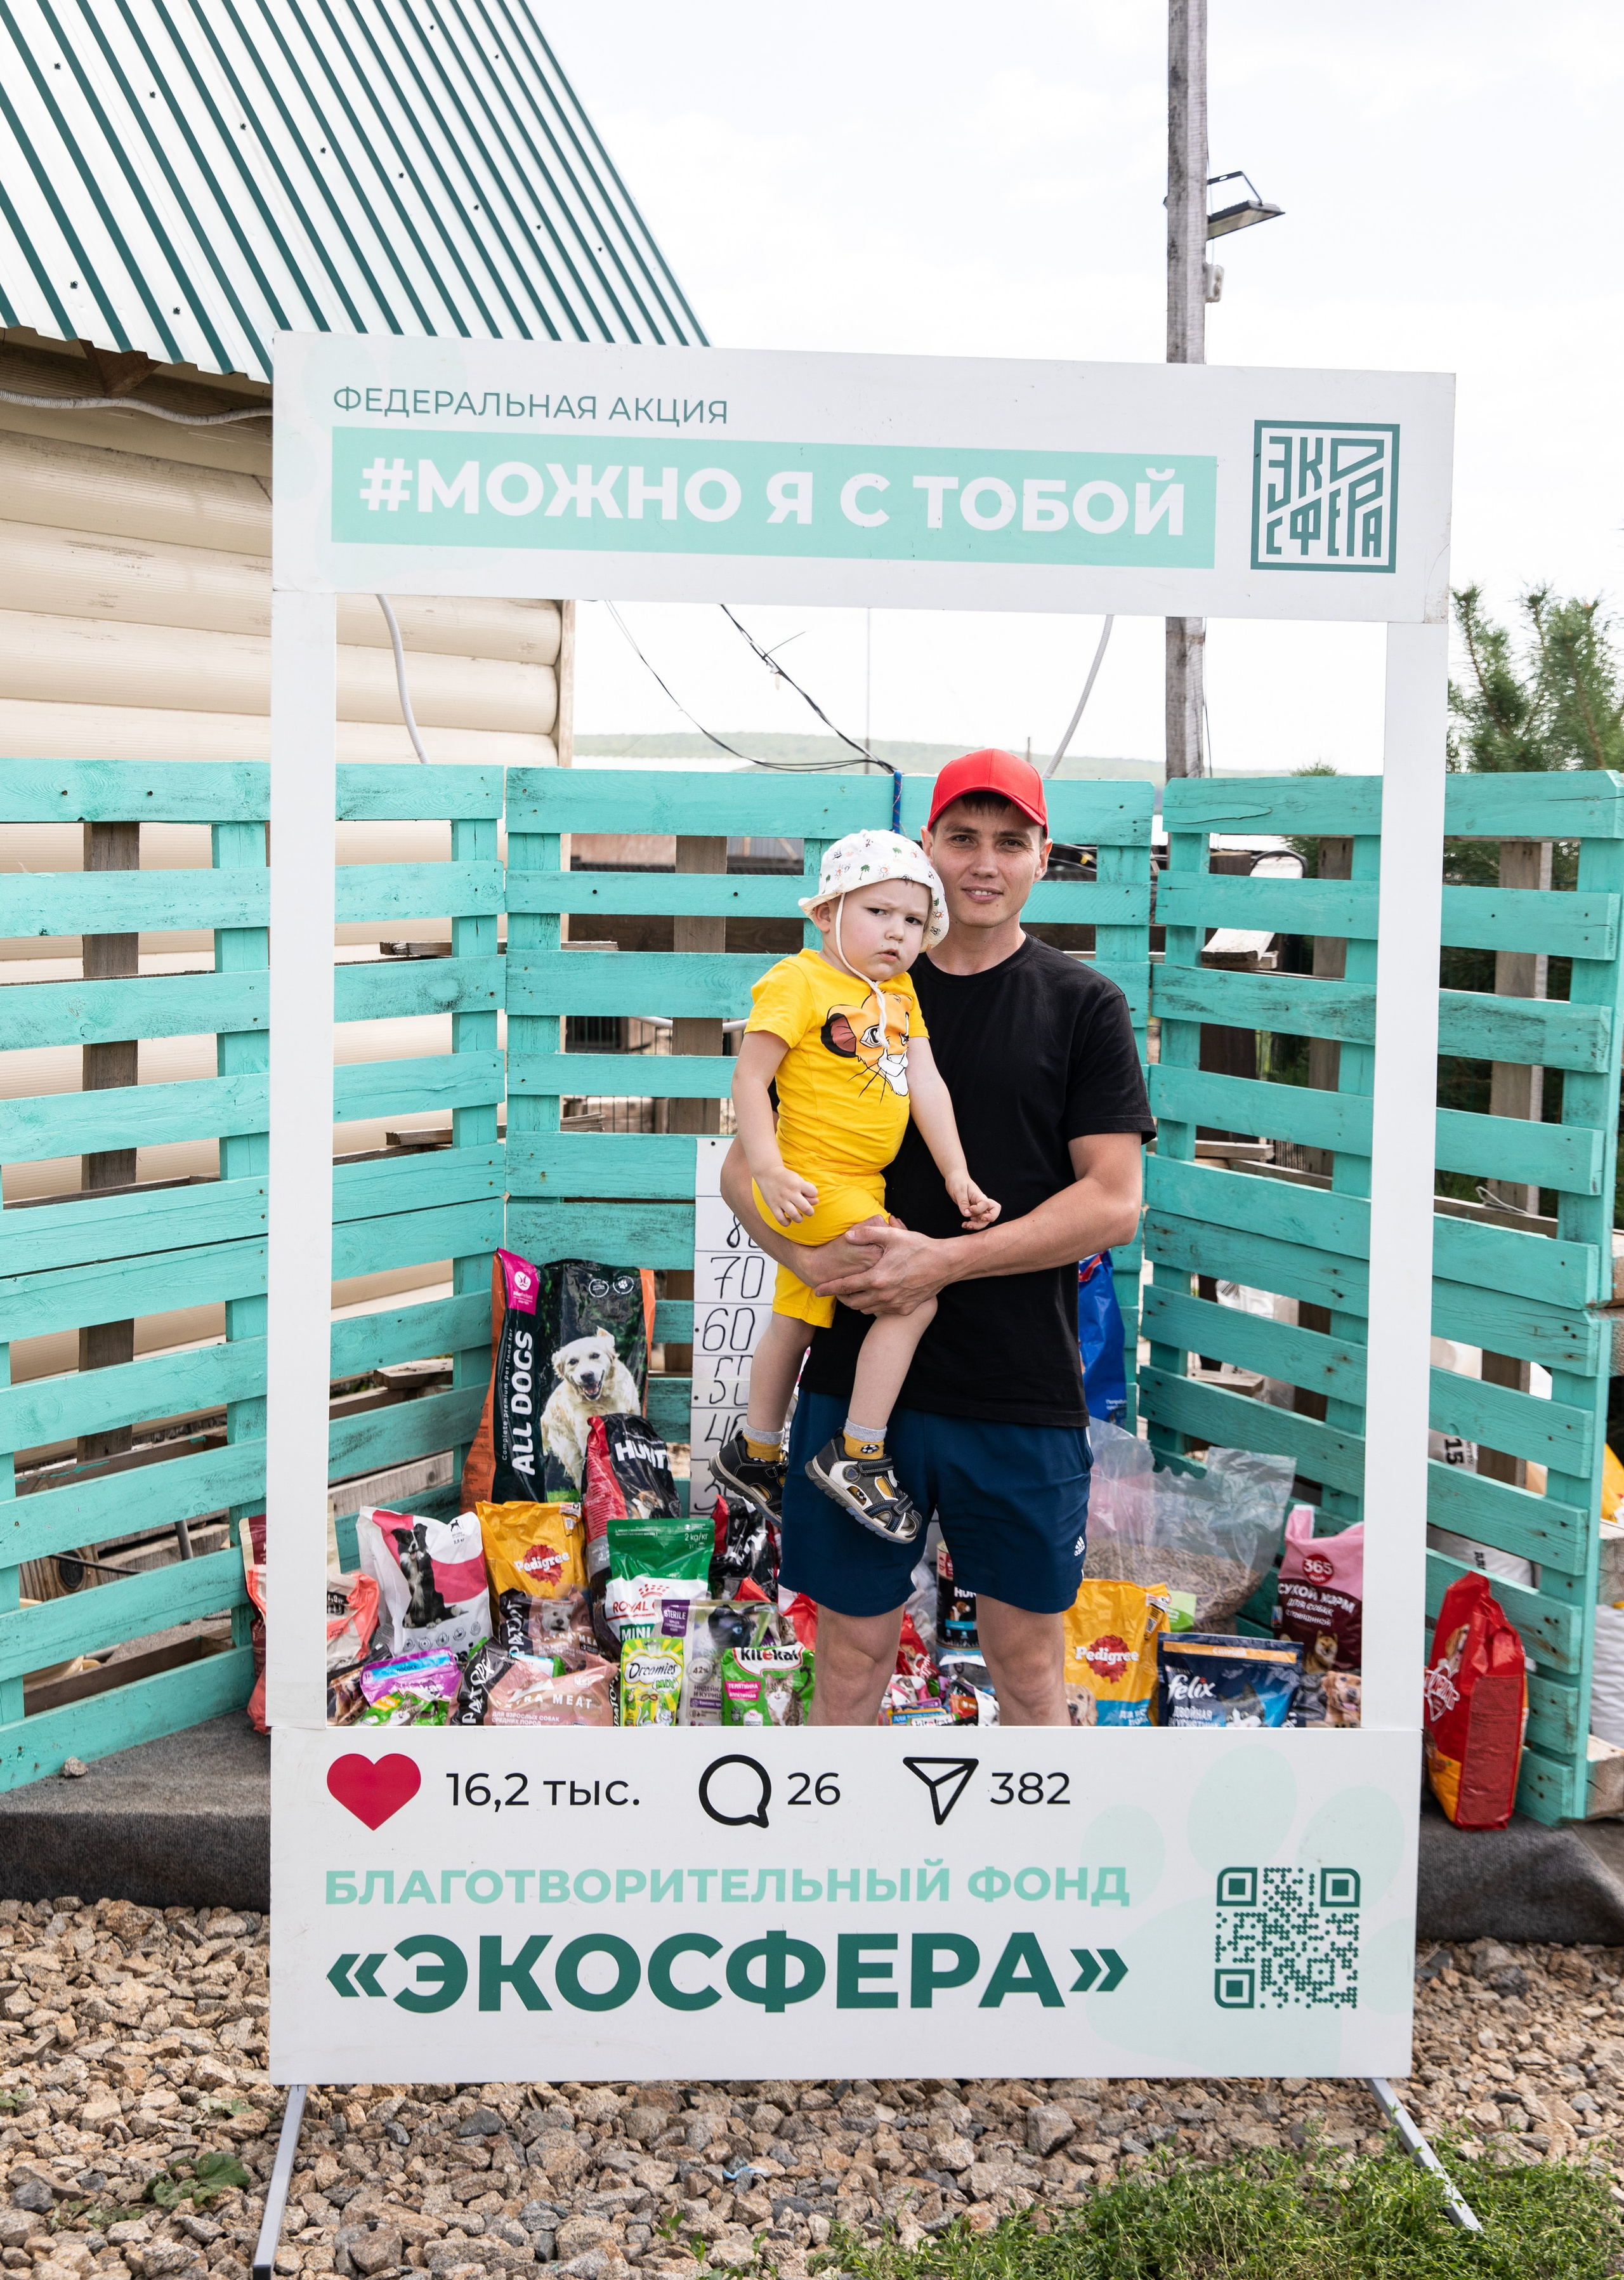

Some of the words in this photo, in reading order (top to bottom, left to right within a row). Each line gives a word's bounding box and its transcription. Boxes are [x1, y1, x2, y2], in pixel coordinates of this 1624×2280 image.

[333, 386, 598, 419] ФЕДЕРАЛЬНАЯ
[608, 397, 728, 428] АКЦИЯ
[359, 457, 742, 523] #МОЖНО
[766, 471, 813, 525] Я
[840, 473, 891, 527] С
[912, 467, 1184, 536] ТОБОЙ
[710, 1255, 765, 1299] 70
[702, 1307, 755, 1351] 60
[511, 1330, 534, 1416] DOGS
[512, 1421, 536, 1476] ALL
[1444, 1437, 1465, 1465] 15
[684, 1533, 690, 1541] 2
[513, 1552, 570, 1572] Pedigree
[1303, 1558, 1333, 1575] 365
[612, 1600, 648, 1614] ROYAL
[1278, 1583, 1318, 1601] СУХОЙ
[1320, 1593, 1356, 1614] КОРМ
[1287, 1598, 1306, 1609] ДЛЯ
[1306, 1602, 1334, 1617] СОБАК
[664, 1609, 686, 1620] STERILE
[579, 1633, 598, 1648] MEA
[621, 1626, 651, 1641] MINI
[740, 1646, 799, 1661] kitekat
[1075, 1645, 1139, 1666] Pedigree
[629, 1663, 678, 1679] Dreamies
[656, 1678, 675, 1690] MIX
[553, 1694, 593, 1710] MEAT
[1166, 1673, 1216, 1704] felix
[446, 1772, 529, 1813] 16,2
[542, 1779, 640, 1807] тыс.
[787, 1772, 841, 1805] 26
[989, 1772, 1071, 1805] 382
[325, 1858, 950, 1904] БЛАГОТВОРИТЕЛЬНЫЙ
[967, 1866, 1130, 1908] ФОНД
[325, 1930, 1129, 2013] «ЭКОСФЕРА»
